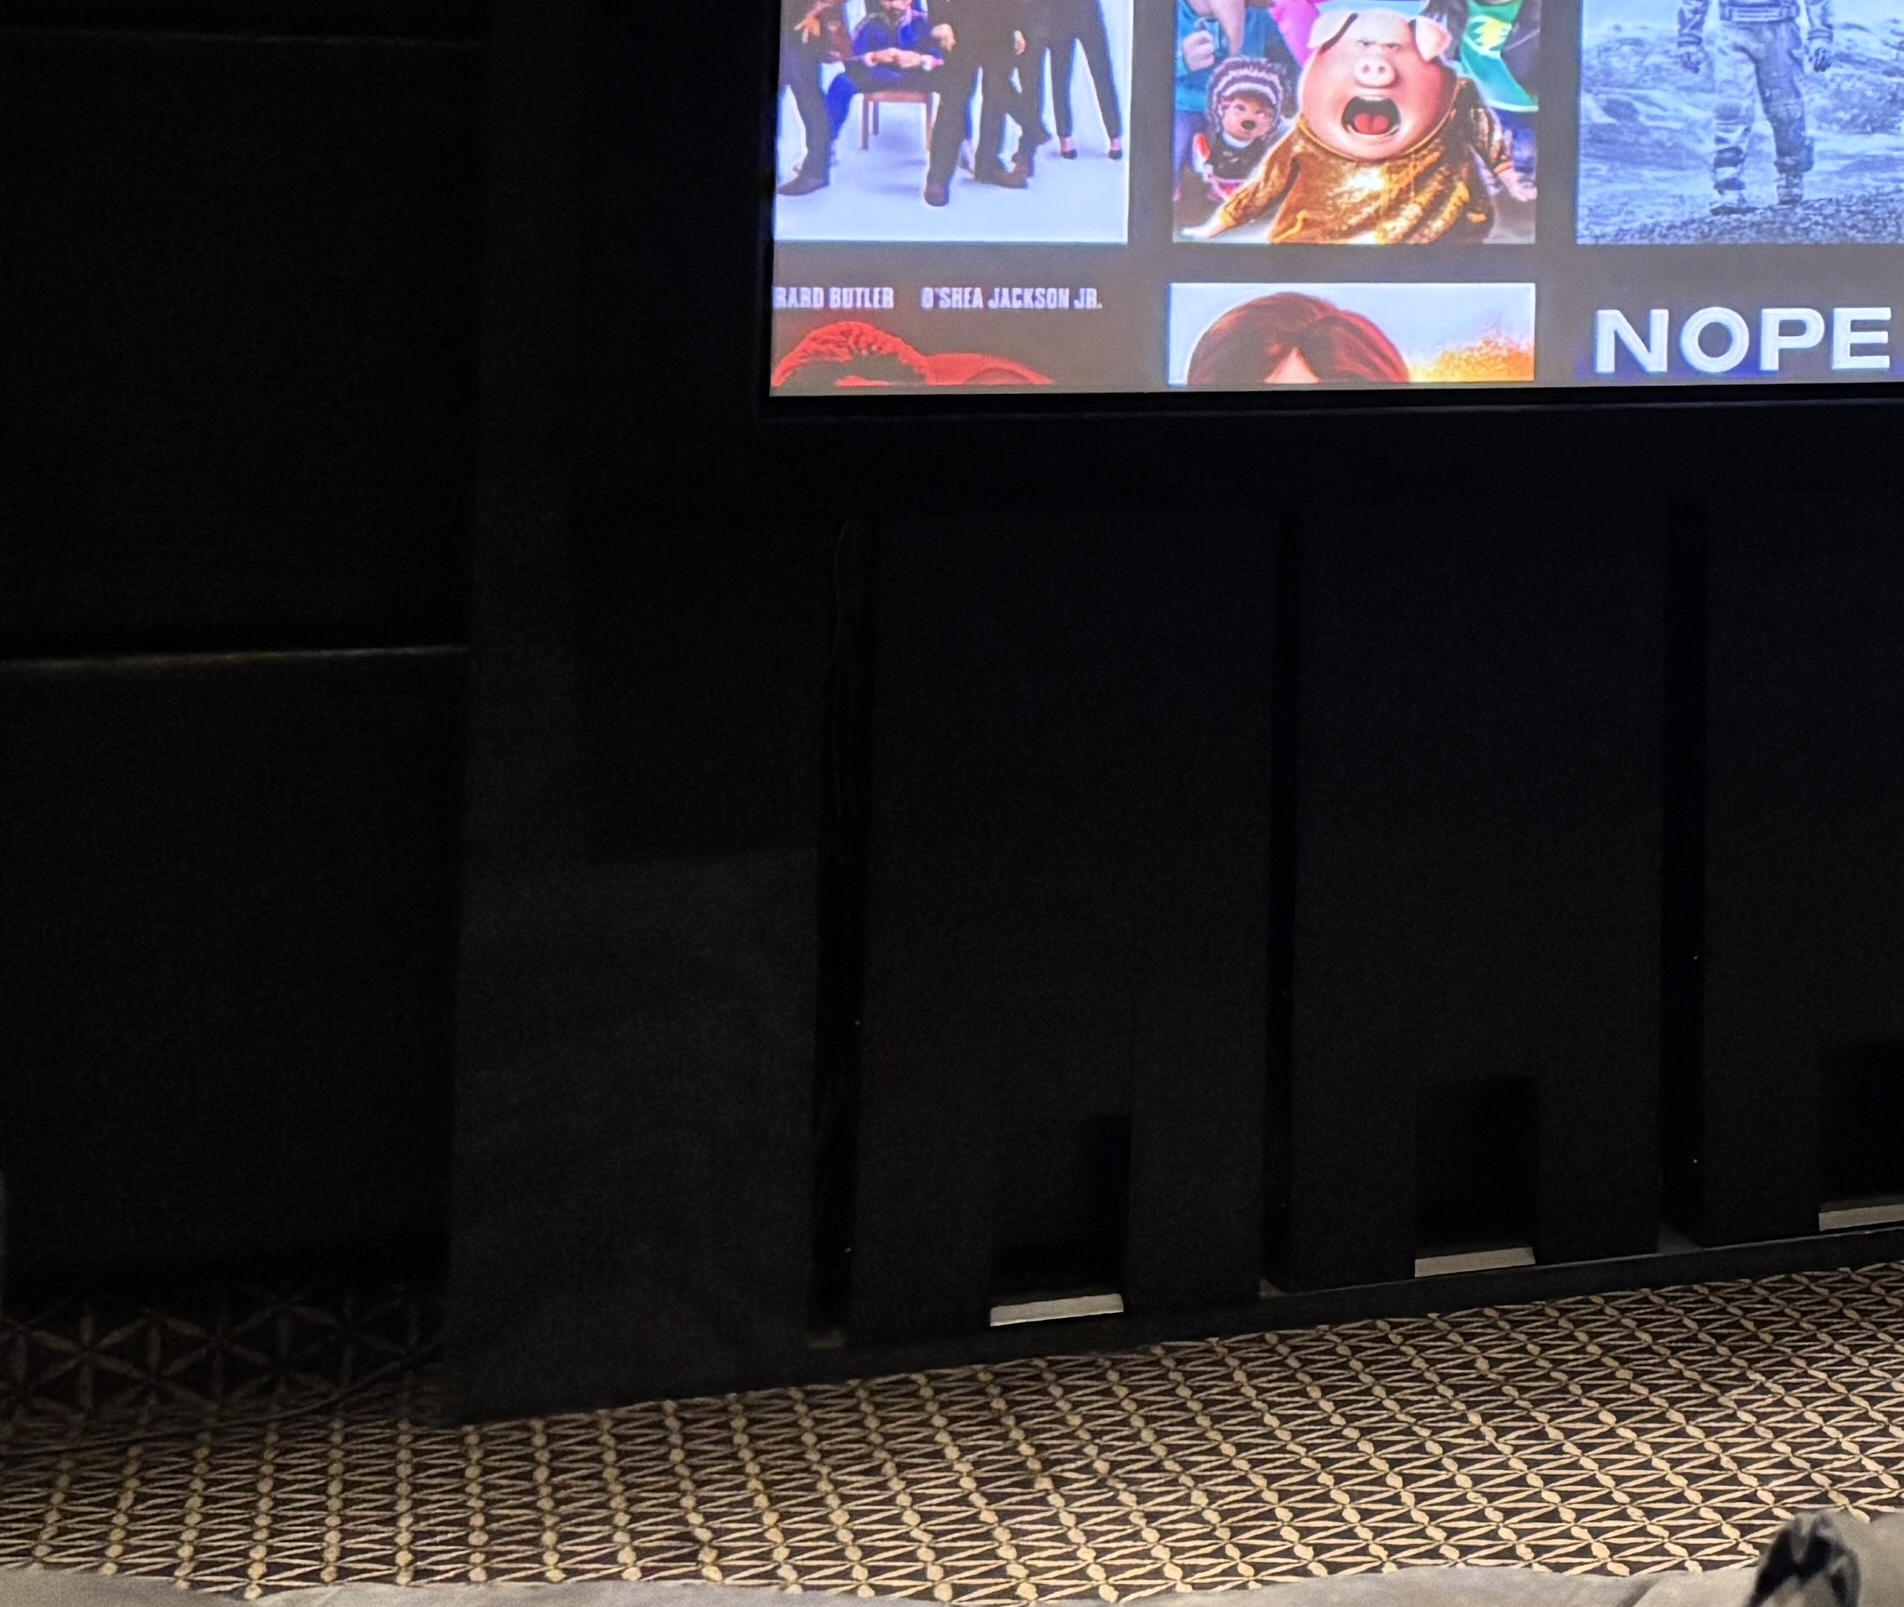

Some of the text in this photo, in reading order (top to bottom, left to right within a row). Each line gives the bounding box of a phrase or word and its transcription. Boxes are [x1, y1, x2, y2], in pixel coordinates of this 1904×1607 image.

[828, 287, 894, 309] BUTLER
[920, 287, 984, 309] O'SHEA
[987, 287, 1069, 309] JACKSON
[1073, 288, 1102, 309] JR.
[1595, 306, 1891, 373] NOPE
